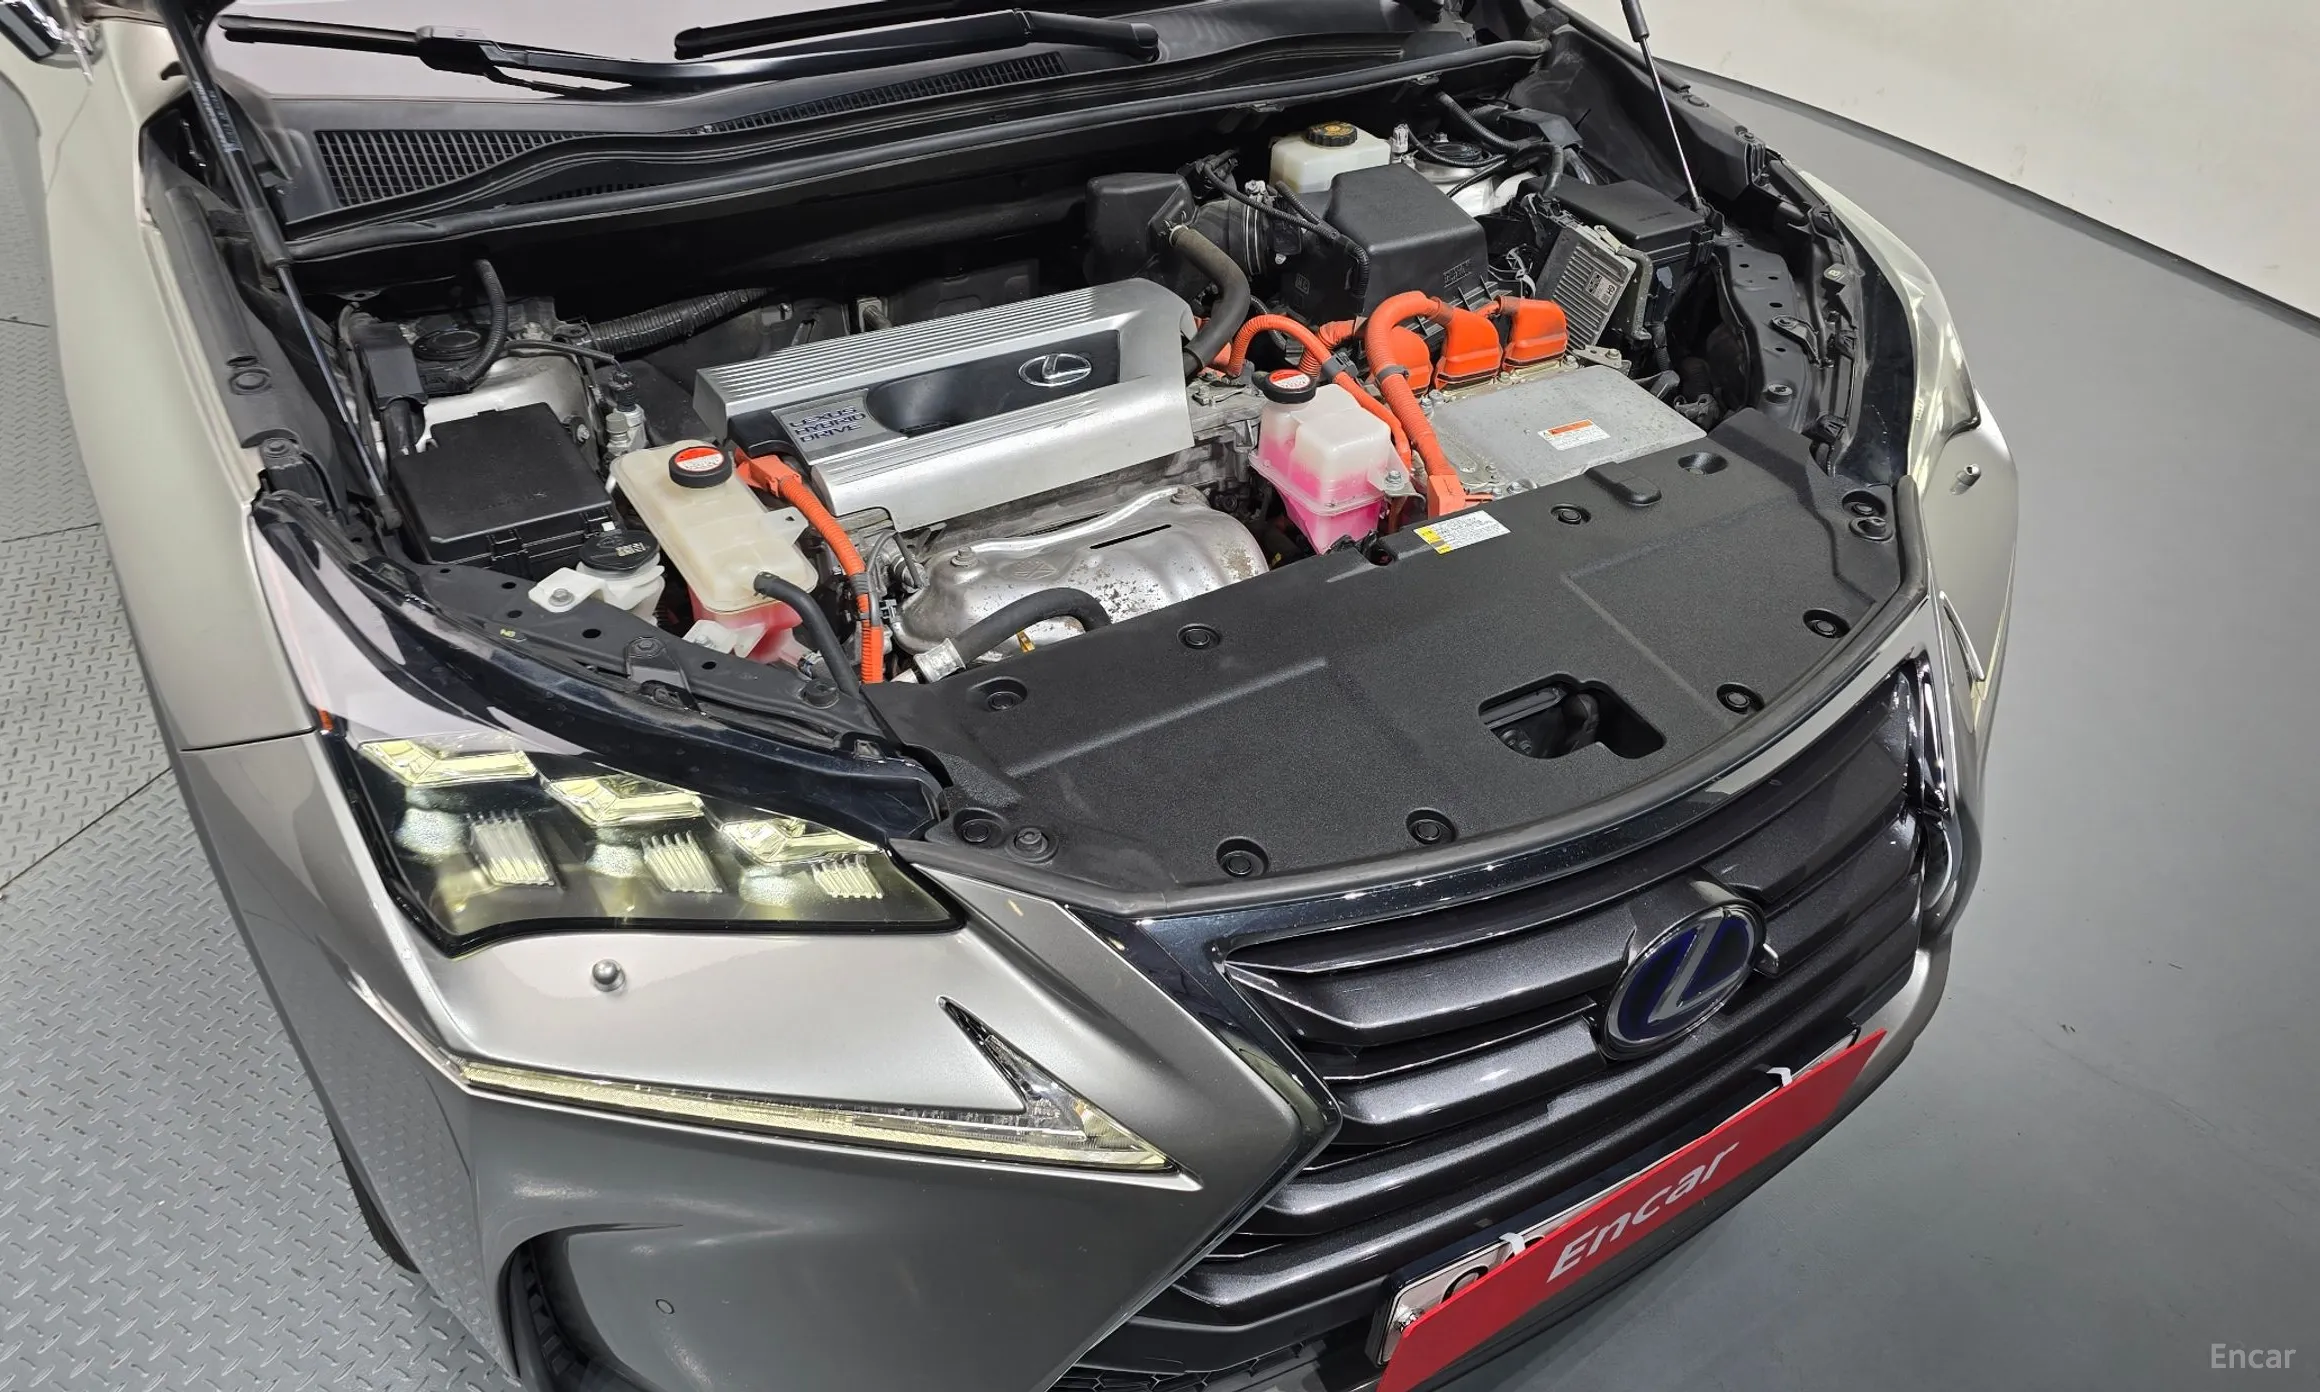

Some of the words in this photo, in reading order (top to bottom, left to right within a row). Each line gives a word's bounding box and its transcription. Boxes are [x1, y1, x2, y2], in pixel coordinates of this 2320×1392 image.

[789, 406, 857, 427] LEXUS
[795, 412, 866, 435] HYBRID
[800, 422, 861, 443] DRIVE
[1546, 1141, 1740, 1284] Encar
